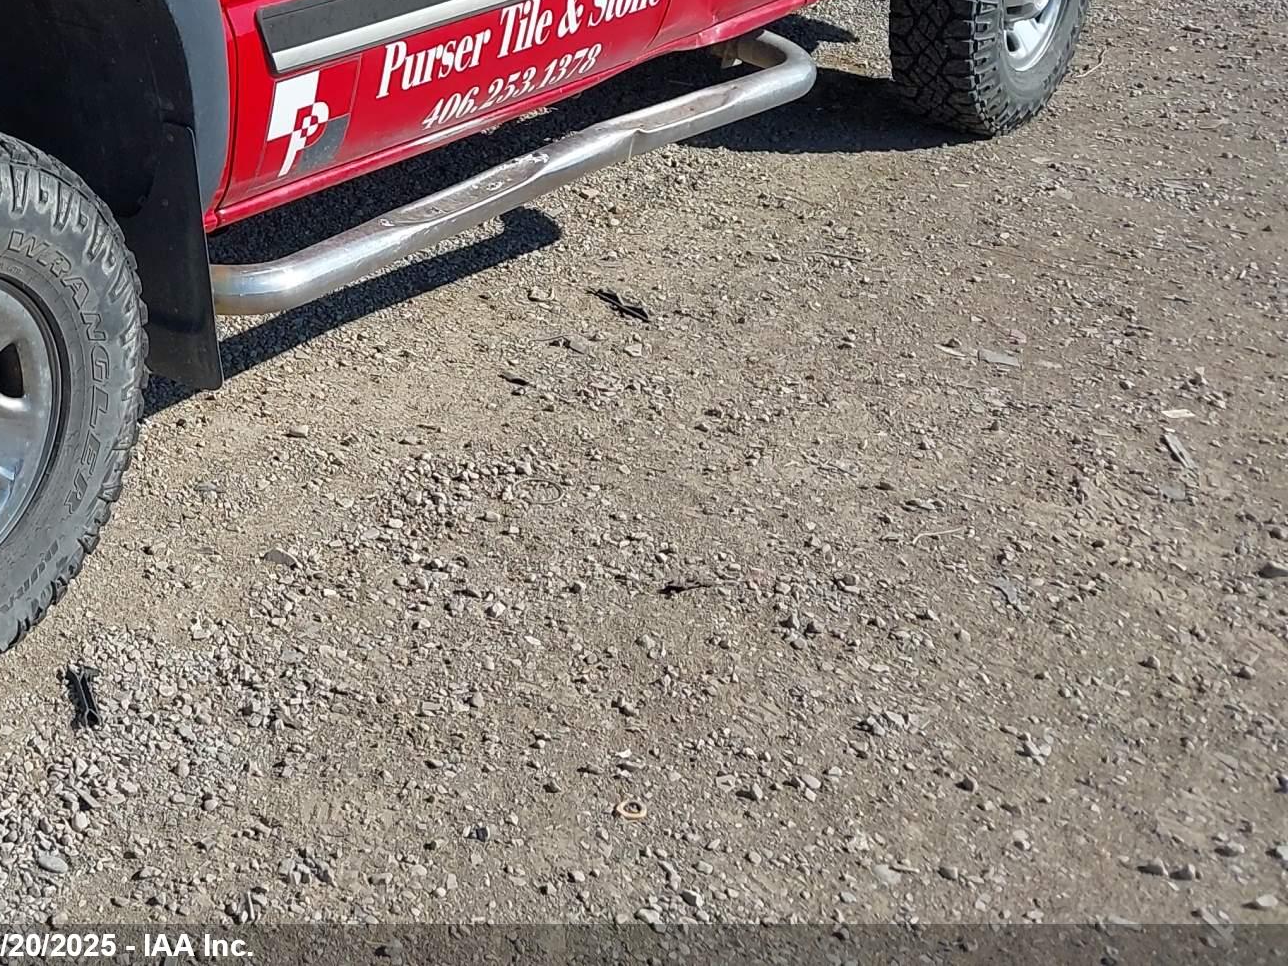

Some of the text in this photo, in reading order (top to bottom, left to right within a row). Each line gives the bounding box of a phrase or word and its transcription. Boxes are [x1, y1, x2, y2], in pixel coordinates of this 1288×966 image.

[376, 39, 491, 99] Purser
[422, 44, 602, 130] 406.253.1378
[6, 228, 110, 518] WRANGLER
